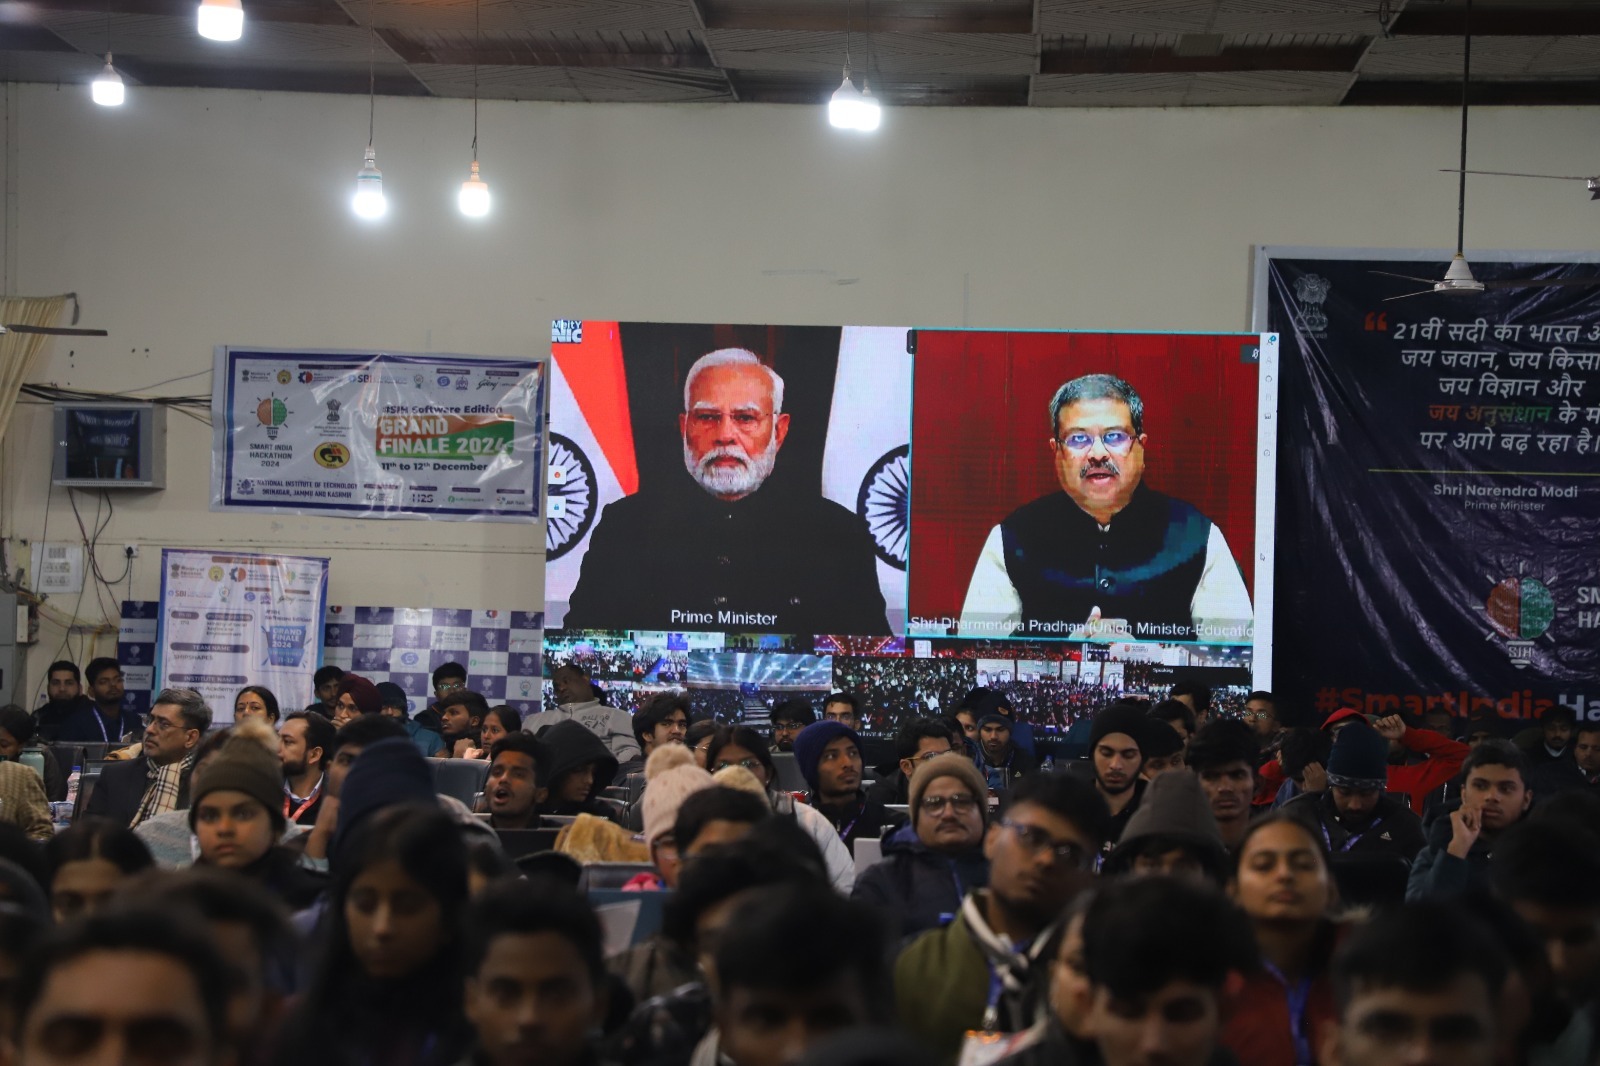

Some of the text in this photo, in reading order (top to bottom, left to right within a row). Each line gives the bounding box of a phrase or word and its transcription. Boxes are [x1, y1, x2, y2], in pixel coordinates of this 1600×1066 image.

[552, 329, 582, 343] NIC
[1393, 317, 1446, 340] 21वीं
[1448, 317, 1489, 343] सदी
[1494, 323, 1523, 342] का
[1529, 323, 1582, 343] भारत
[1401, 349, 1436, 367] जय
[1441, 350, 1500, 371] जवान,
[1509, 351, 1543, 369] जय
[1439, 372, 1586, 399] जय विज्ञान और
[464, 404, 503, 414] Edition
[1429, 404, 1461, 422] जय
[1465, 402, 1553, 427] अनुसंधान
[1558, 400, 1581, 424] के
[381, 418, 449, 435] GRAND
[380, 437, 449, 454] FINALE
[1420, 431, 1447, 449] पर
[1453, 426, 1495, 450] आगे
[1500, 433, 1531, 455] बढ़
[1537, 434, 1571, 453] रहा
[249, 452, 293, 460] HACKATHON
[399, 463, 410, 471] to
[433, 463, 488, 471] December
[1433, 484, 1578, 498] Shri Narendra Modi
[1464, 500, 1546, 511] Prime Minister
[671, 609, 778, 625] Prime Minister
[910, 617, 938, 630] Shri
[941, 617, 1025, 632] Dharmendra
[1029, 619, 1085, 633] Pradhan
